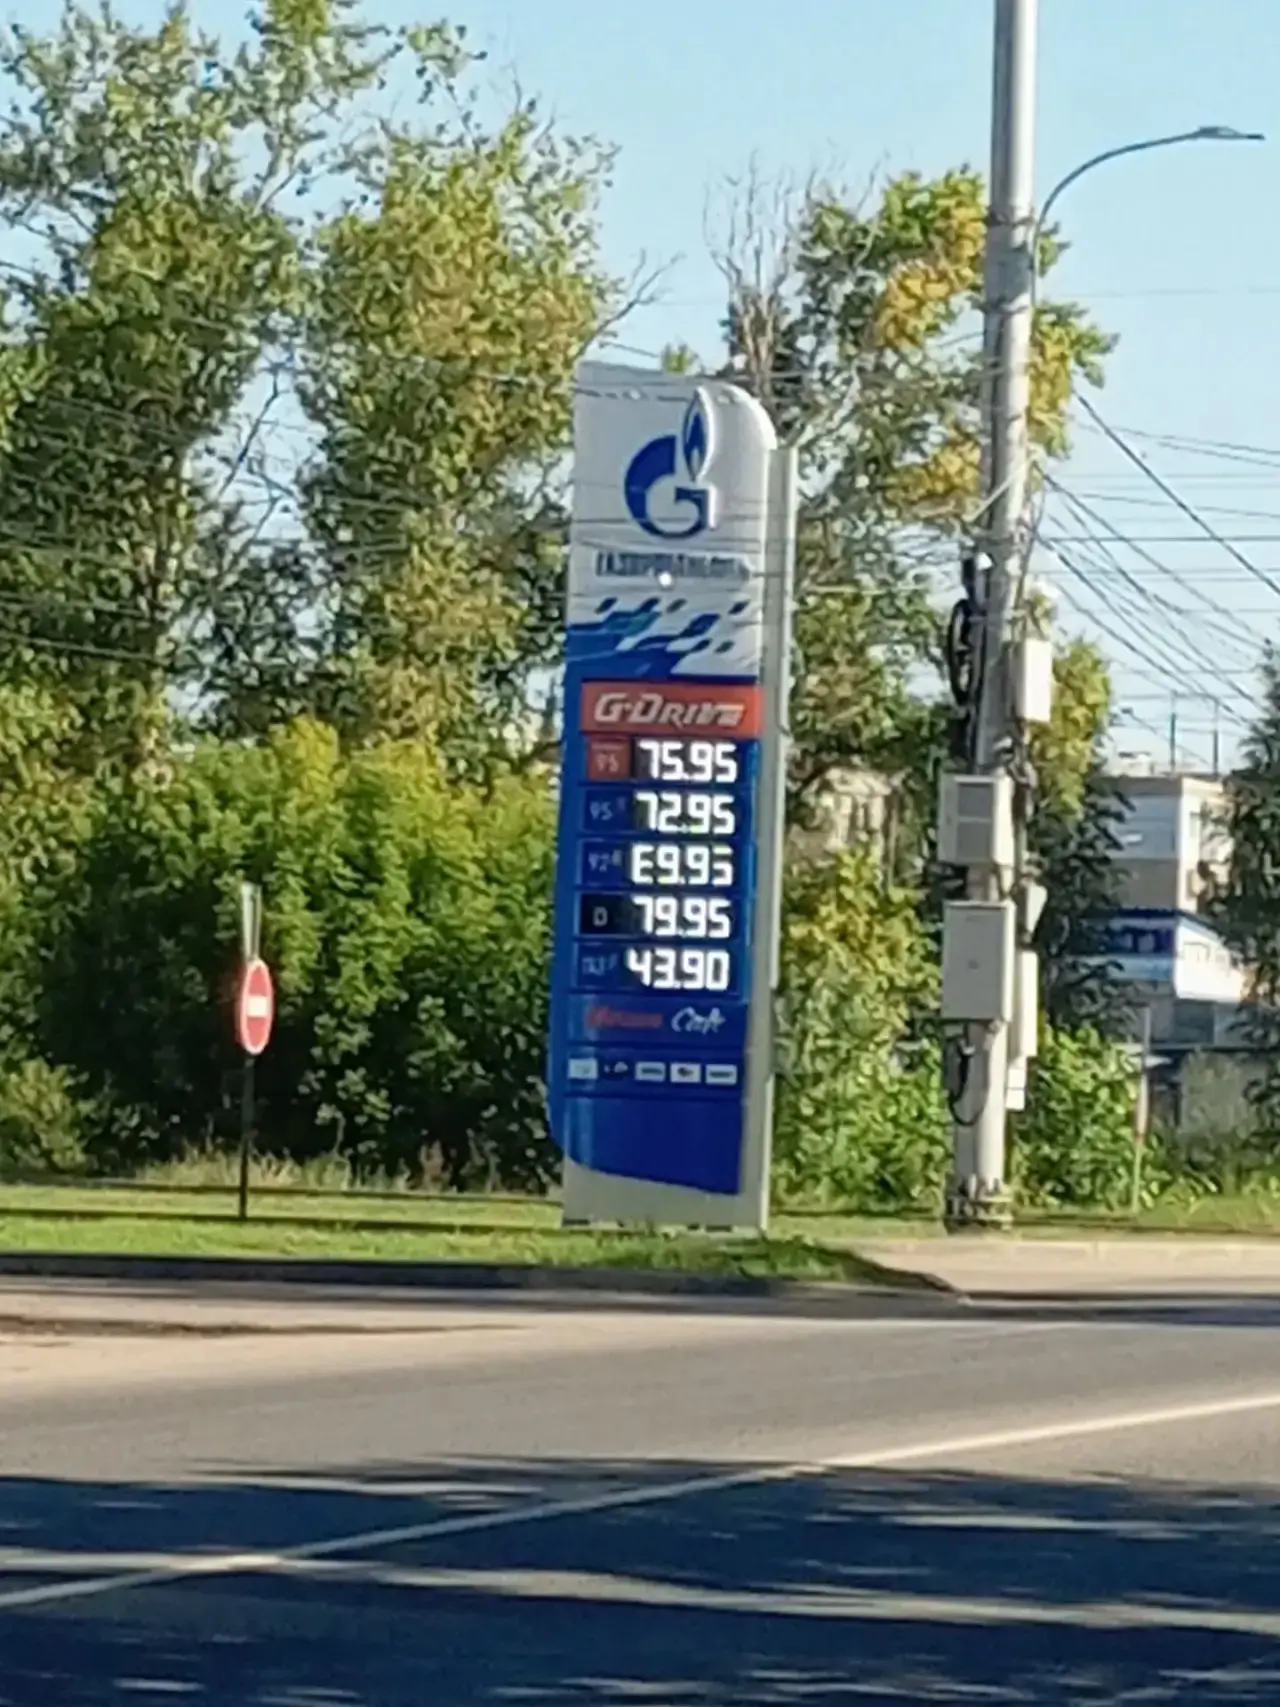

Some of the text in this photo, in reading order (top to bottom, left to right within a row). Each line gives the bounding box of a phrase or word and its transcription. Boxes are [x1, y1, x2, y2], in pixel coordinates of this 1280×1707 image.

[638, 738, 738, 784] 75.95
[635, 791, 735, 835] 72.95
[631, 894, 732, 939] 79.95
[626, 948, 730, 991] 43.90
